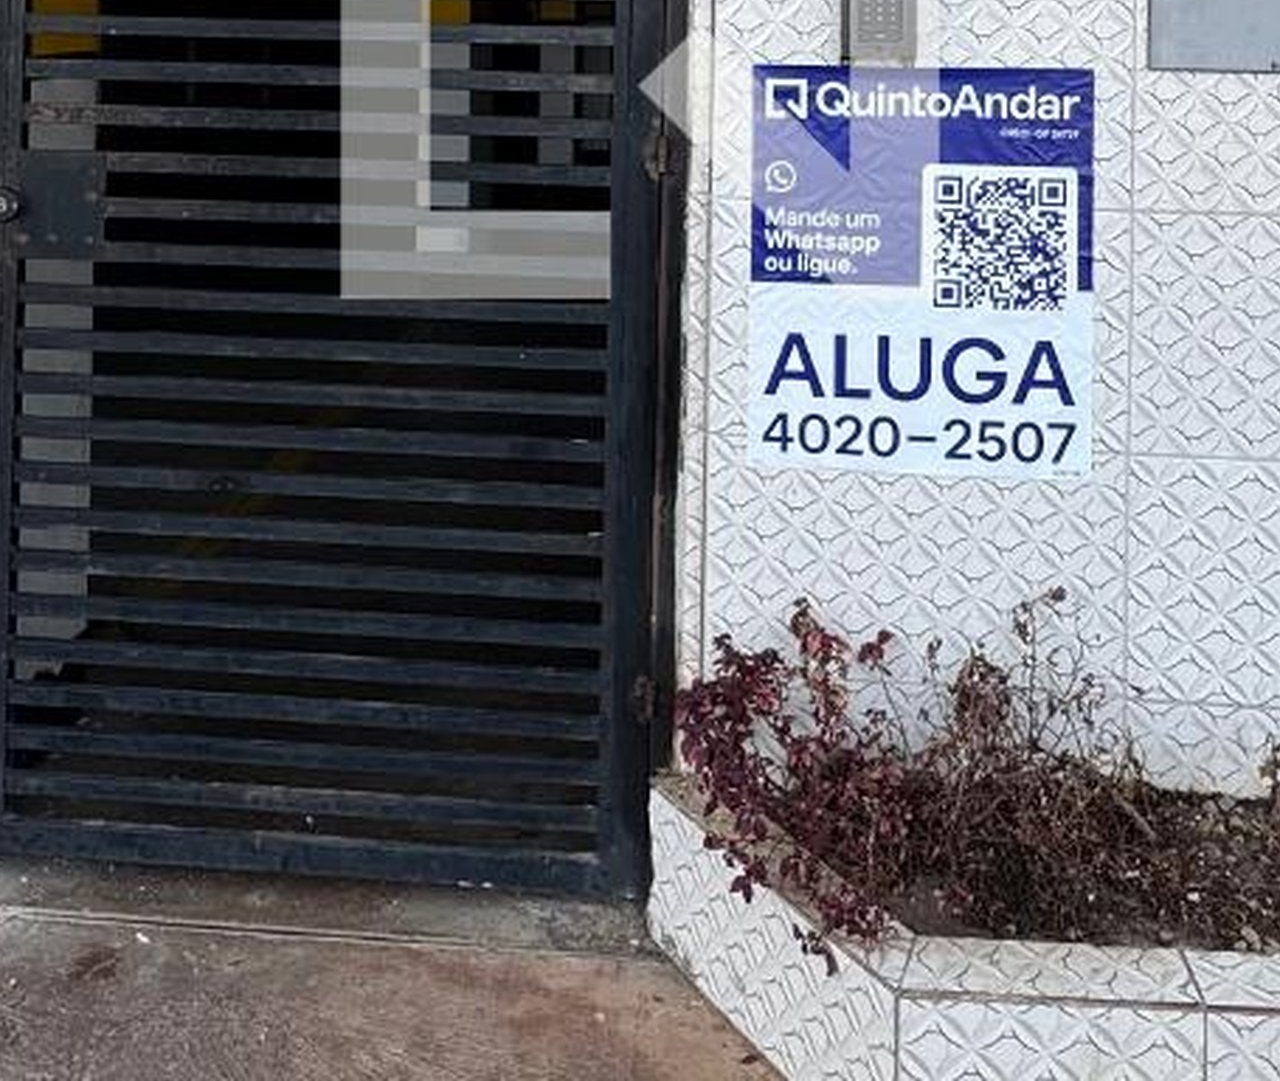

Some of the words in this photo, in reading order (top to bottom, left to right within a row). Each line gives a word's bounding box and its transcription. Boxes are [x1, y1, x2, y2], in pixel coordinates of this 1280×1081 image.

[815, 80, 1081, 121] QuintoAndar
[765, 206, 840, 227] Mande
[846, 212, 880, 229] um
[764, 228, 881, 256] Whatsapp
[764, 255, 792, 272] ou
[798, 252, 858, 277] ligue.
[763, 332, 1076, 407] ALUGA
[761, 412, 1078, 465] 4020-2507
